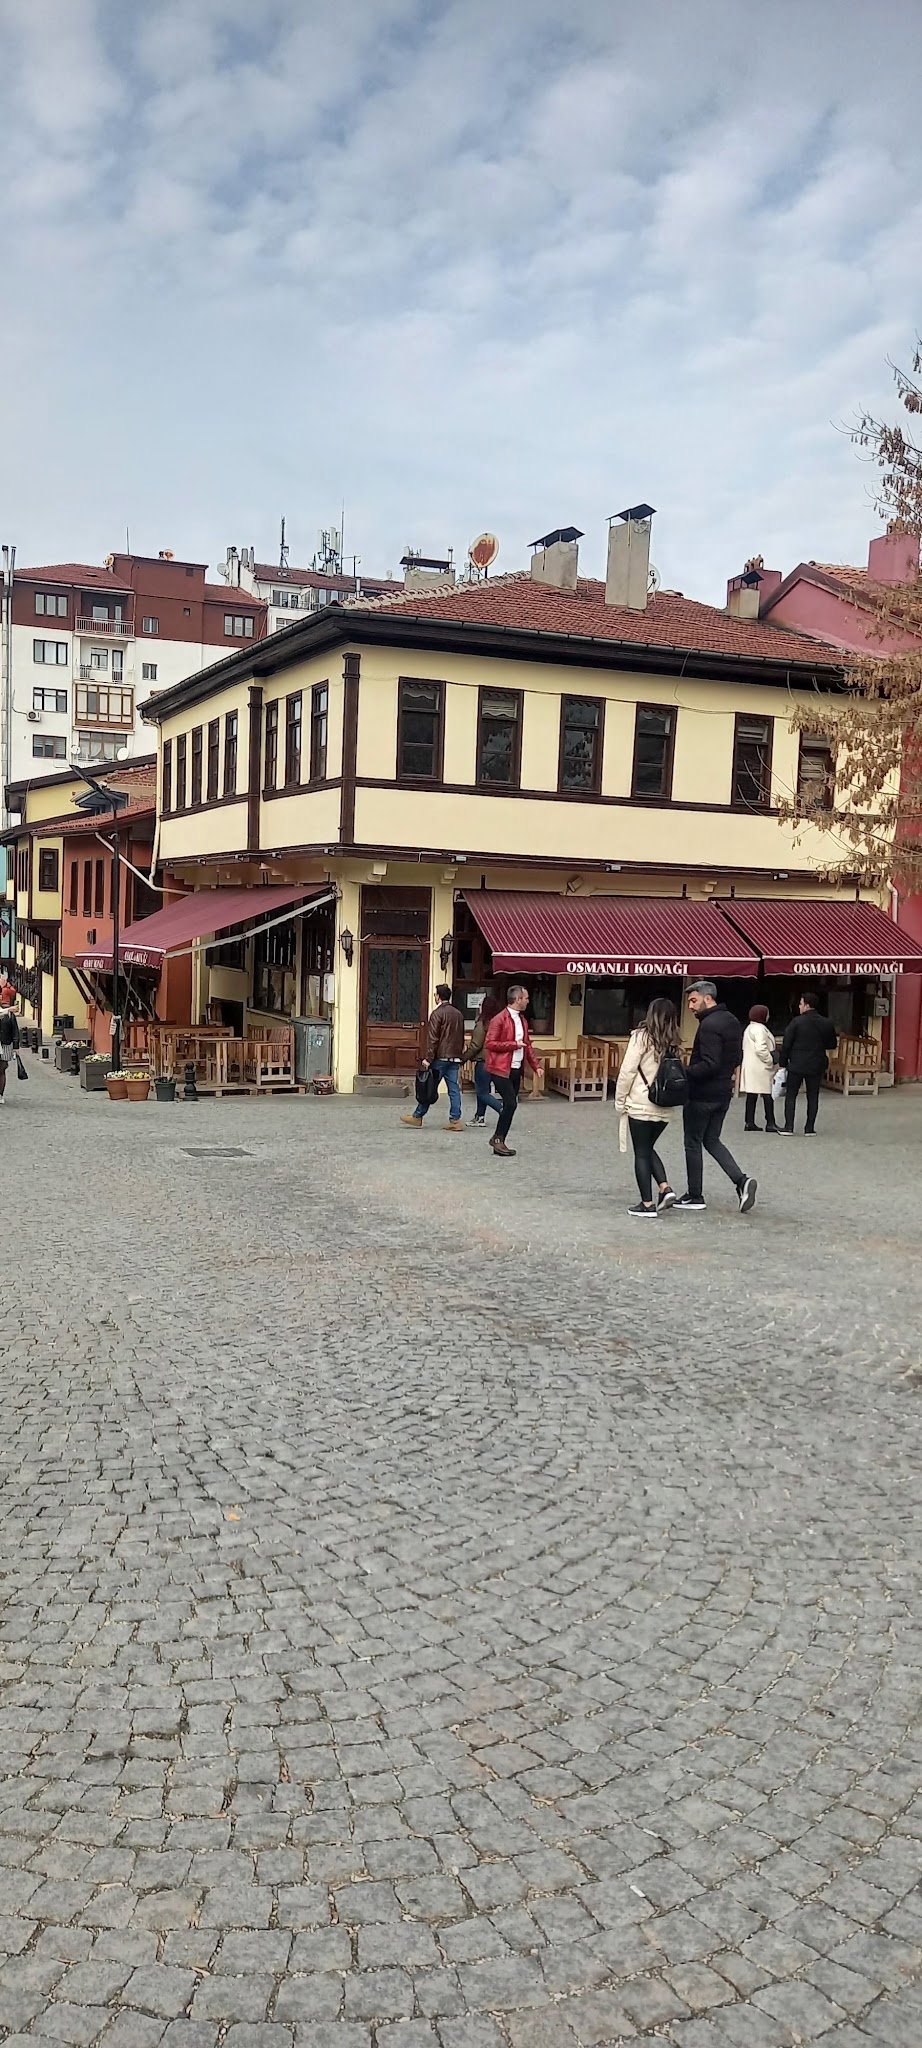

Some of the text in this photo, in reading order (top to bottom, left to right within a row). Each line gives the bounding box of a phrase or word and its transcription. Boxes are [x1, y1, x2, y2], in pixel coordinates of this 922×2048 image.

[566, 961, 689, 975] OSMANLI KONAĞI
[793, 960, 904, 974] OSMANLI KONAĞI
